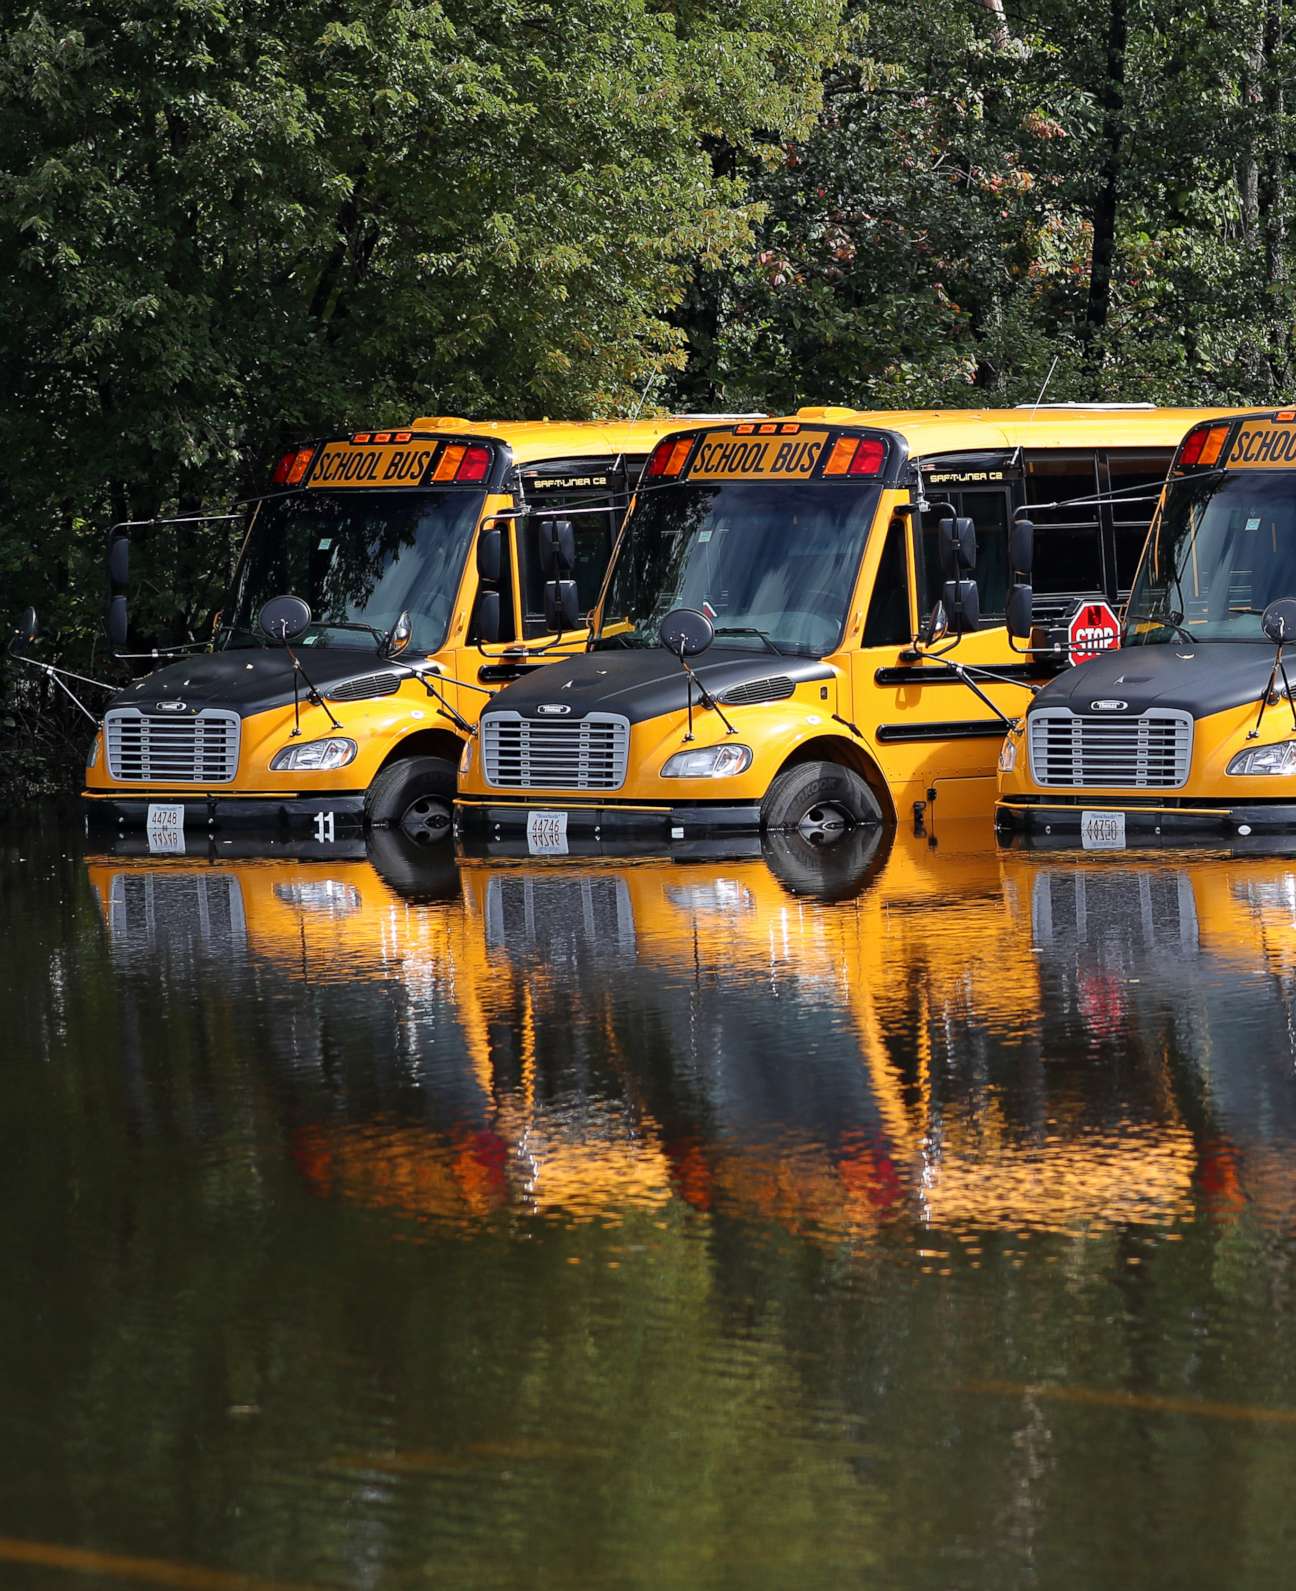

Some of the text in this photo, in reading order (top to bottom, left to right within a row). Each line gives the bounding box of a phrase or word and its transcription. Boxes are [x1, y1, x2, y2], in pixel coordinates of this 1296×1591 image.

[692, 442, 822, 473] SCHOOL BUS
[312, 450, 431, 481] SCHOOL BUS
[592, 477, 607, 485] C2
[989, 471, 1003, 480] C2
[1076, 627, 1114, 656] STOP
[152, 811, 177, 825] 44748
[313, 812, 335, 829] 11
[532, 819, 560, 833] 44746
